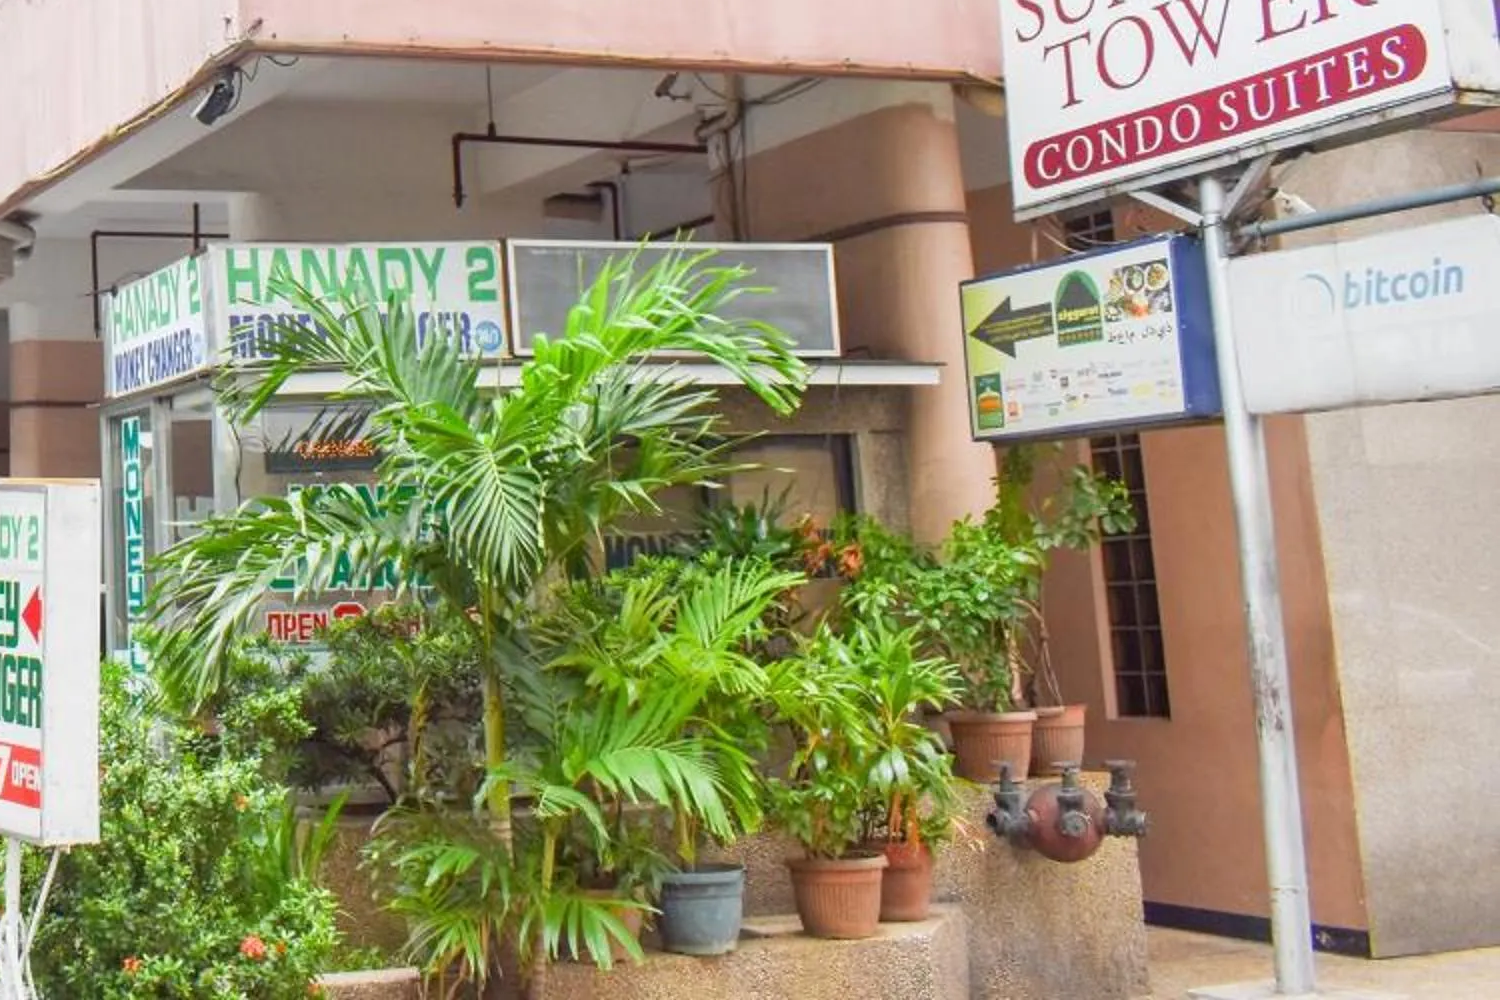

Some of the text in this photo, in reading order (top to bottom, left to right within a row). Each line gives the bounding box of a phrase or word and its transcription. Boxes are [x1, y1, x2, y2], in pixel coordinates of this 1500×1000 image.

[1036, 34, 1406, 182] CONDO SUITES
[113, 257, 200, 345] HANADY 2
[226, 247, 498, 304] HANADY 2
[1343, 256, 1464, 310] bitcoin
[115, 344, 146, 393] MONEY
[27, 515, 39, 561] 2
